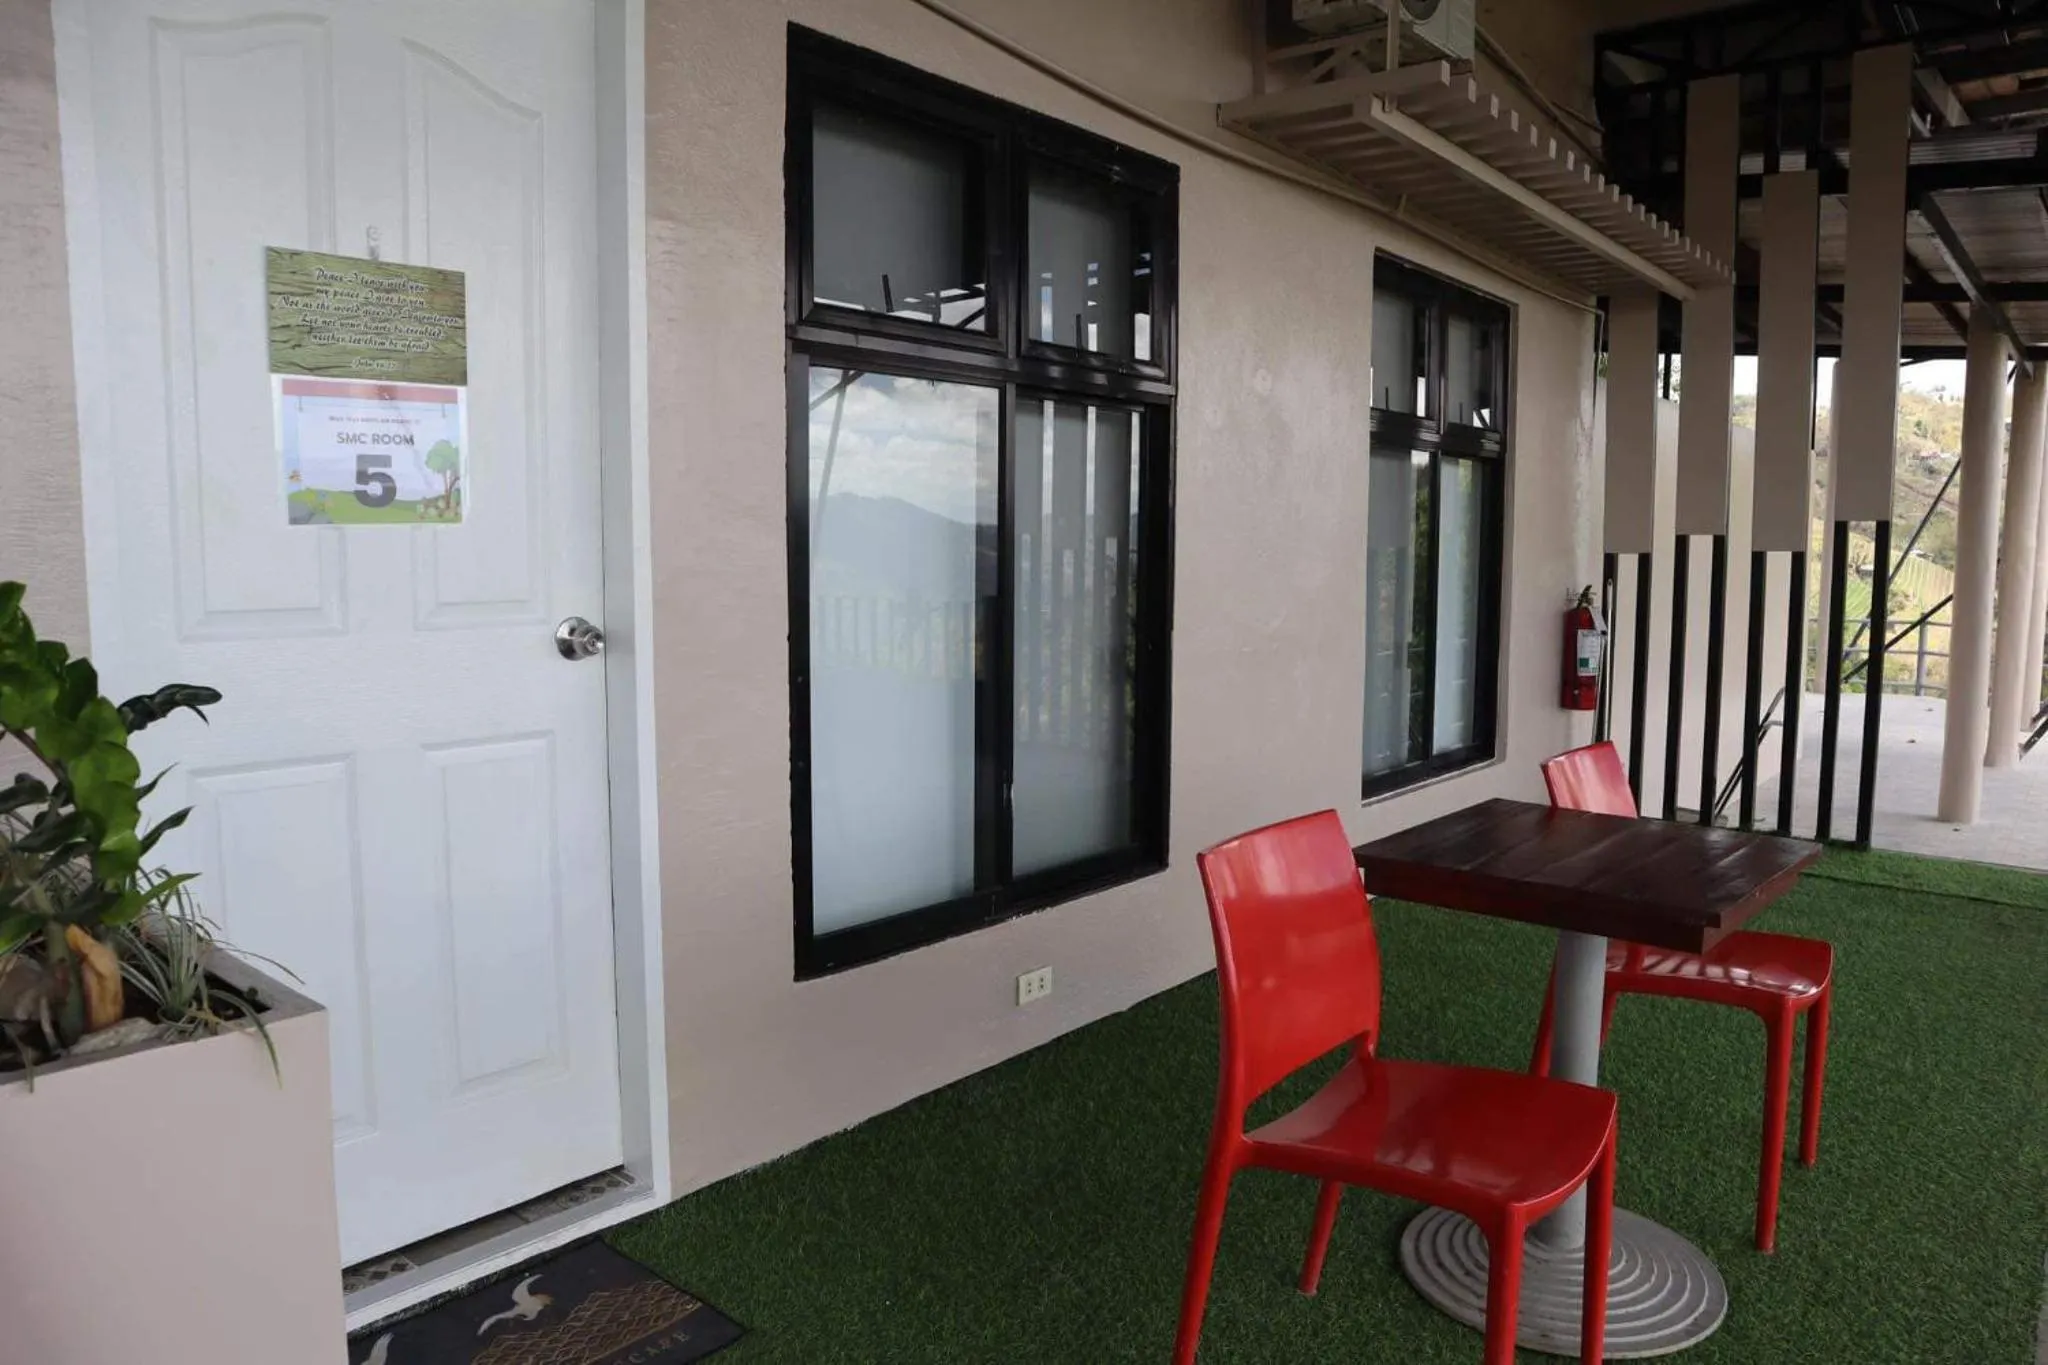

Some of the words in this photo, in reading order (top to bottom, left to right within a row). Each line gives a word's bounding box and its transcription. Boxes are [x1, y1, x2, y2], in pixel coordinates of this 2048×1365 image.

[336, 431, 368, 445] SMC
[371, 433, 415, 446] ROOM
[354, 453, 397, 509] 5
